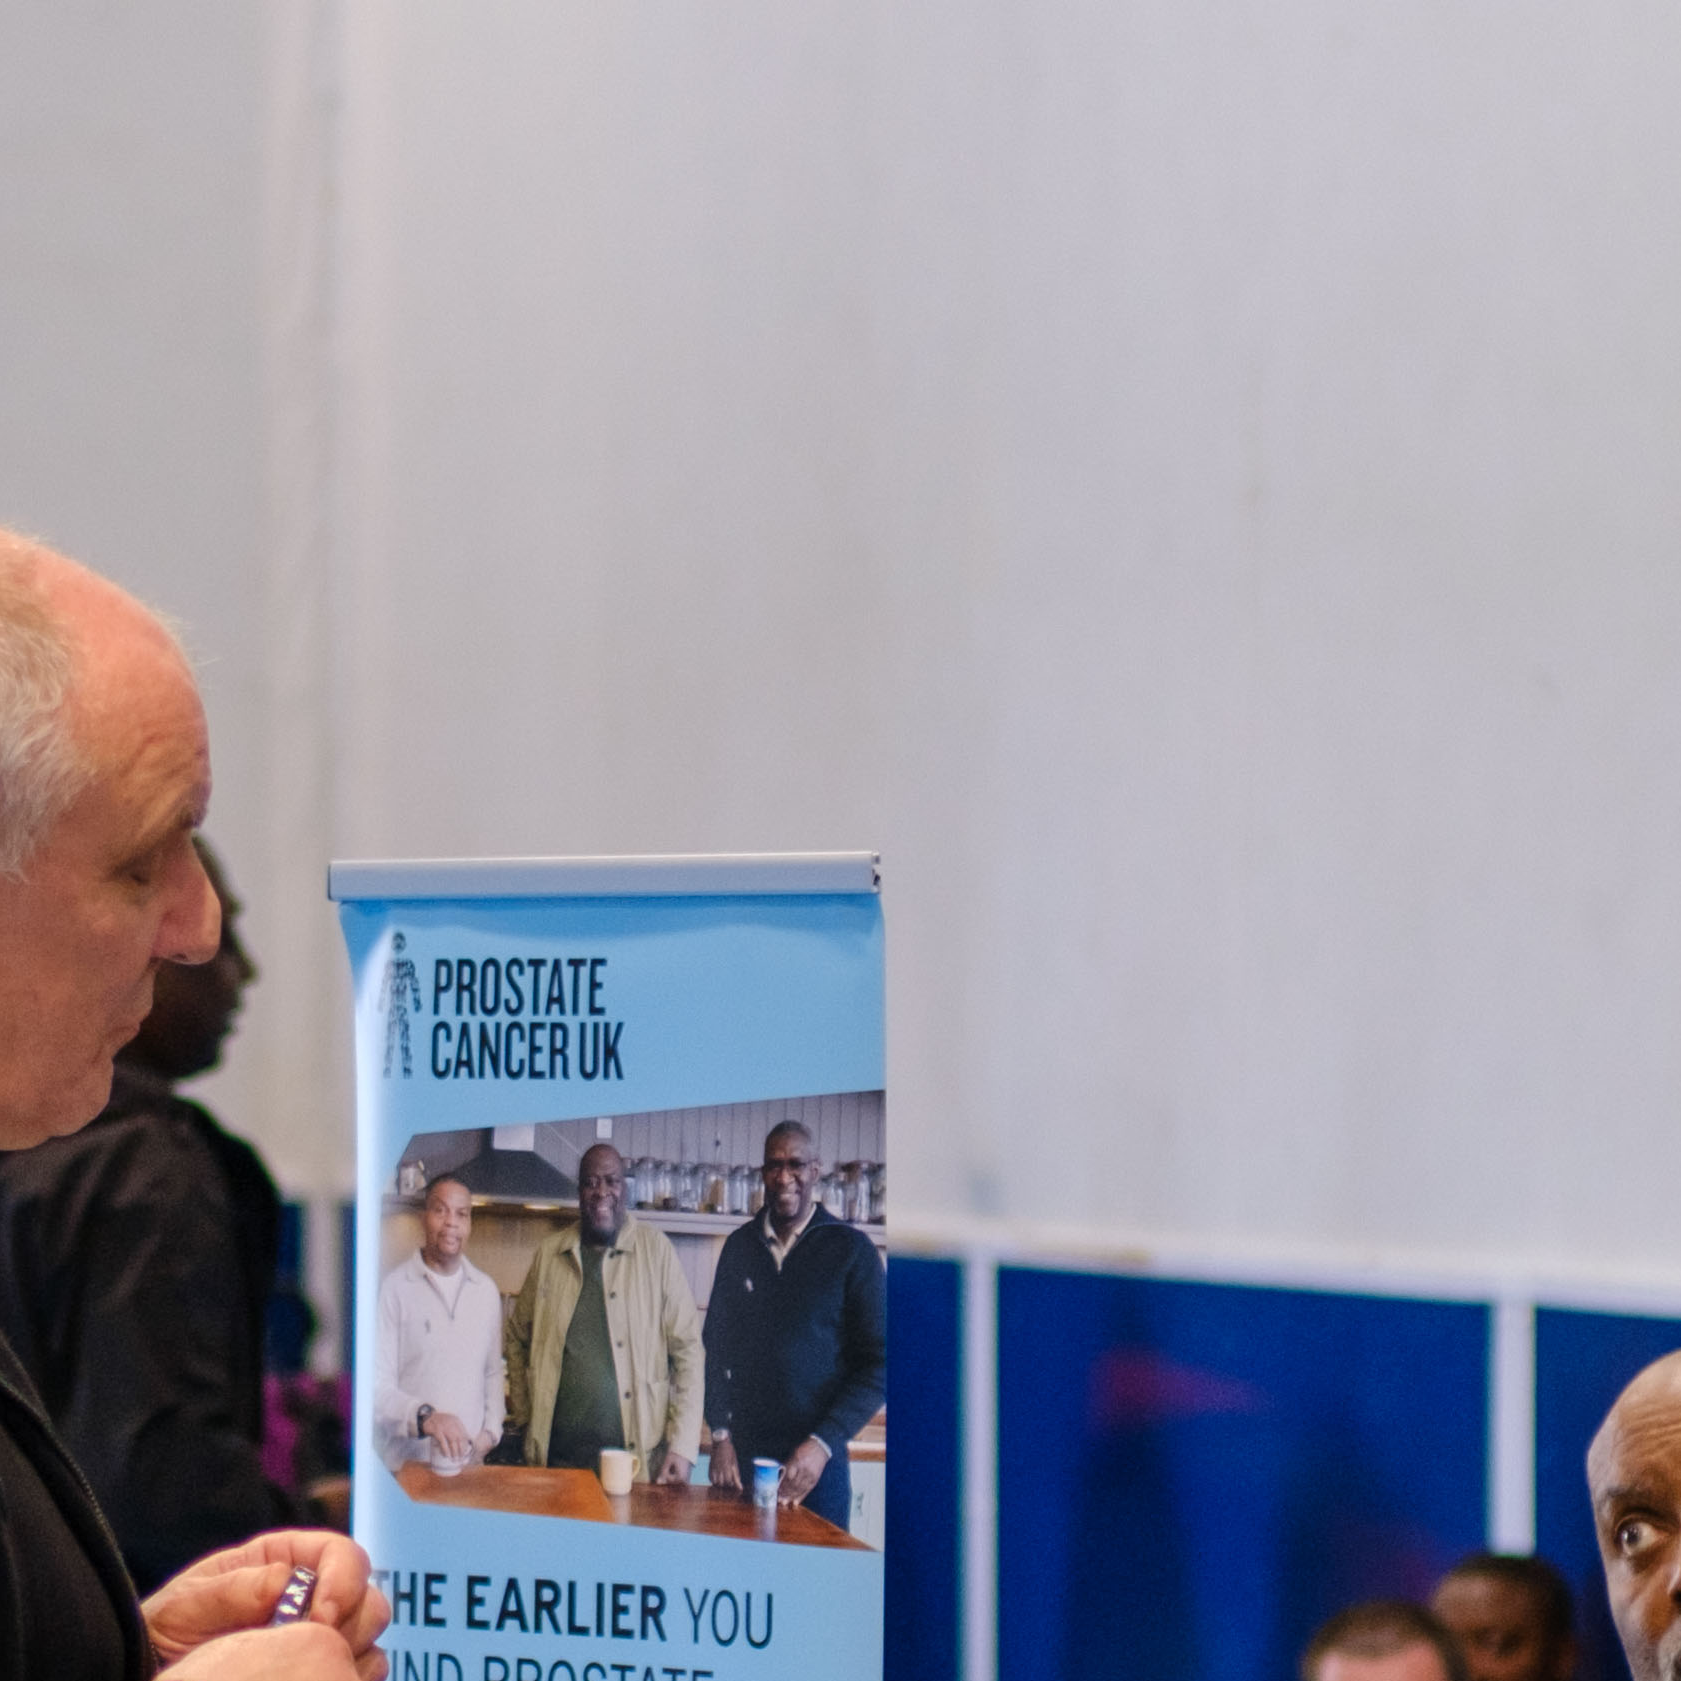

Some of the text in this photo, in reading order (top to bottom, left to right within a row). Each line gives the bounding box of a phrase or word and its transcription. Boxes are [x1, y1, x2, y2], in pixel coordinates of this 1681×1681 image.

[433, 958, 608, 1016] PROSTATE
[431, 1020, 624, 1081] CANCER UK
[466, 1573, 667, 1642] EARLIER
[682, 1586, 774, 1650] YOU
